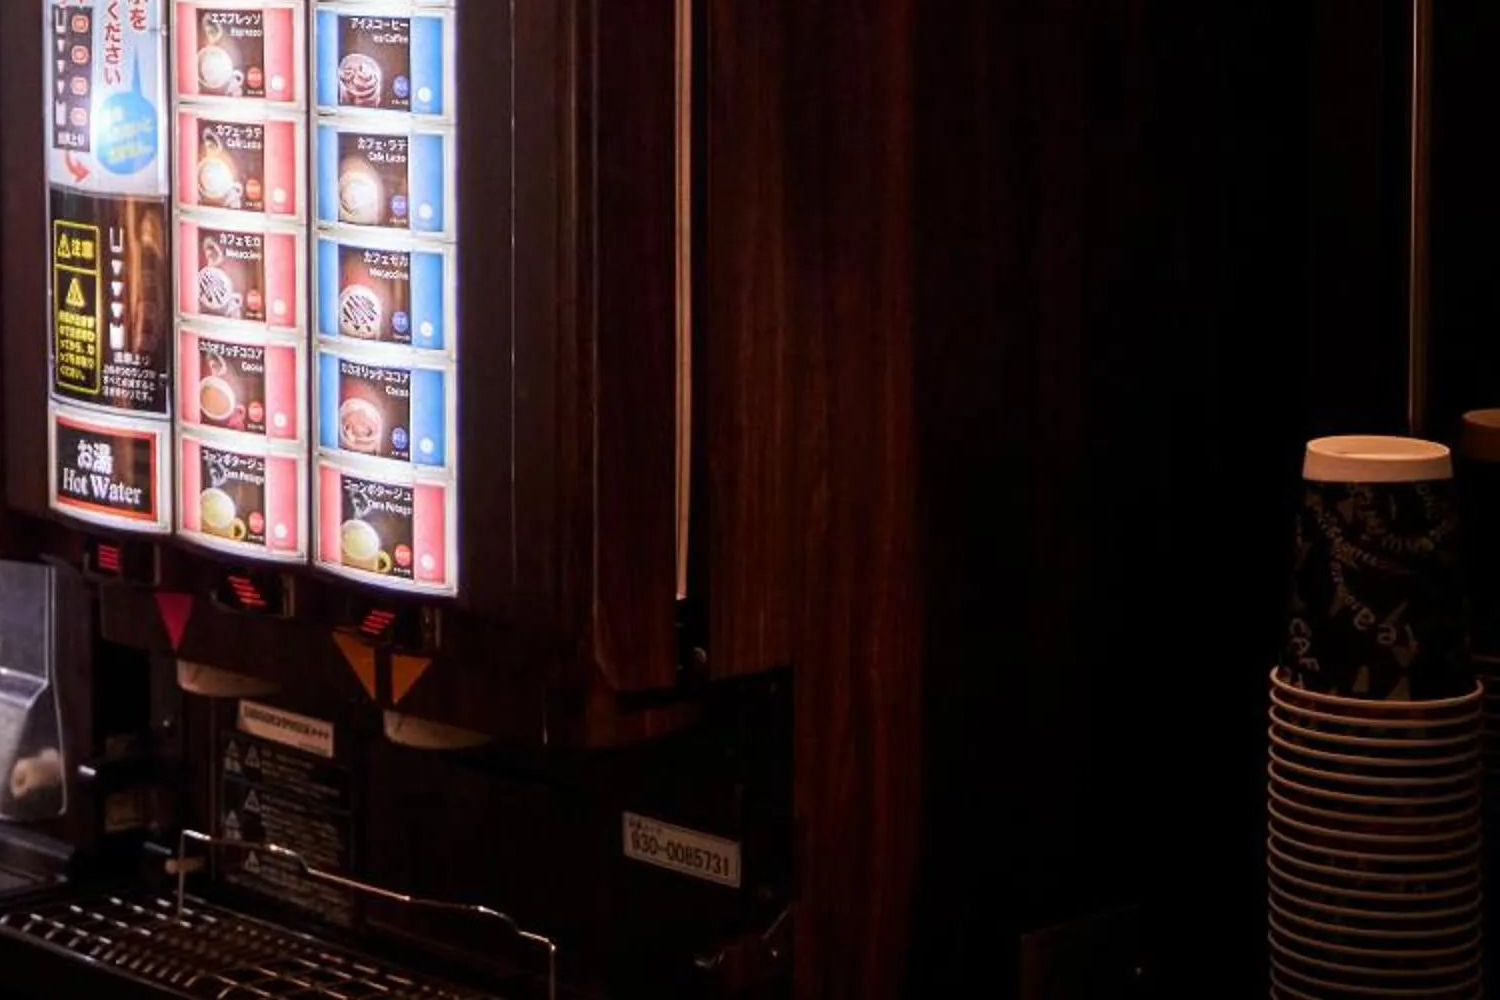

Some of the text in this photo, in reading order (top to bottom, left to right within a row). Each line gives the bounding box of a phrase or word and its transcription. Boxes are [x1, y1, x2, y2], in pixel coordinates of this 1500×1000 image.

[211, 13, 262, 25] エスプレッソ
[350, 17, 409, 30] アイスコーヒー
[77, 439, 113, 475] お湯
[202, 449, 266, 472] コーンポタージュ
[63, 467, 142, 505] Hot Water
[342, 479, 413, 502] コーンポタージュ
